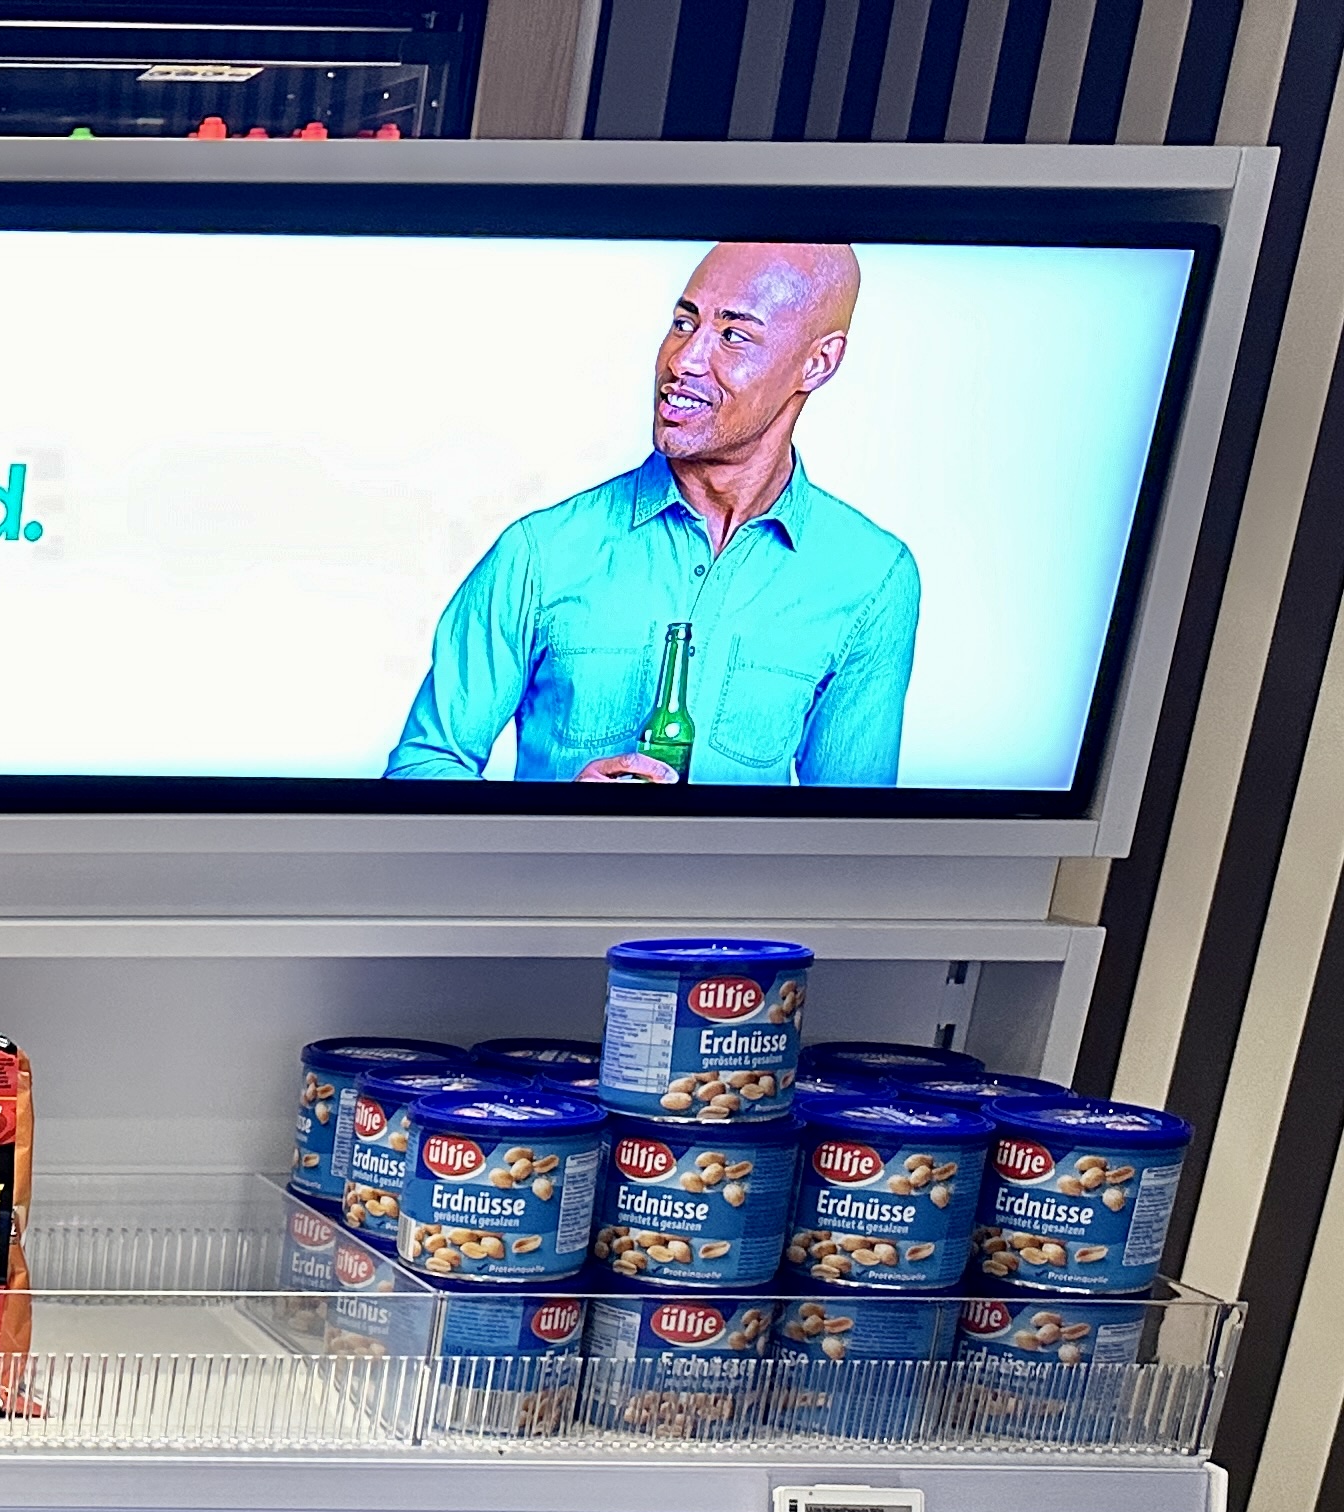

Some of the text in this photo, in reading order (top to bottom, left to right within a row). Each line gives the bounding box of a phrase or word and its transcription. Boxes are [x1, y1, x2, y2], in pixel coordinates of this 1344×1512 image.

[698, 983, 757, 1012] ültje
[699, 1030, 787, 1054] Erdnüsse
[702, 1055, 742, 1068] geröstet
[352, 1146, 406, 1175] Erdnüss
[428, 1138, 476, 1170] ültje
[620, 1141, 667, 1171] ültje
[819, 1145, 873, 1174] ültje
[997, 1140, 1045, 1174] ültje
[432, 1185, 525, 1216] Erdnüsse
[617, 1187, 709, 1220] Erdnüsse
[816, 1190, 916, 1223] Erdnüsse
[995, 1187, 1094, 1225] Erdnüsse
[434, 1211, 519, 1228] geröstet gesalzen
[1042, 1222, 1085, 1236] gesalzen
[538, 1304, 581, 1332] ültje
[660, 1304, 718, 1336] ültje
